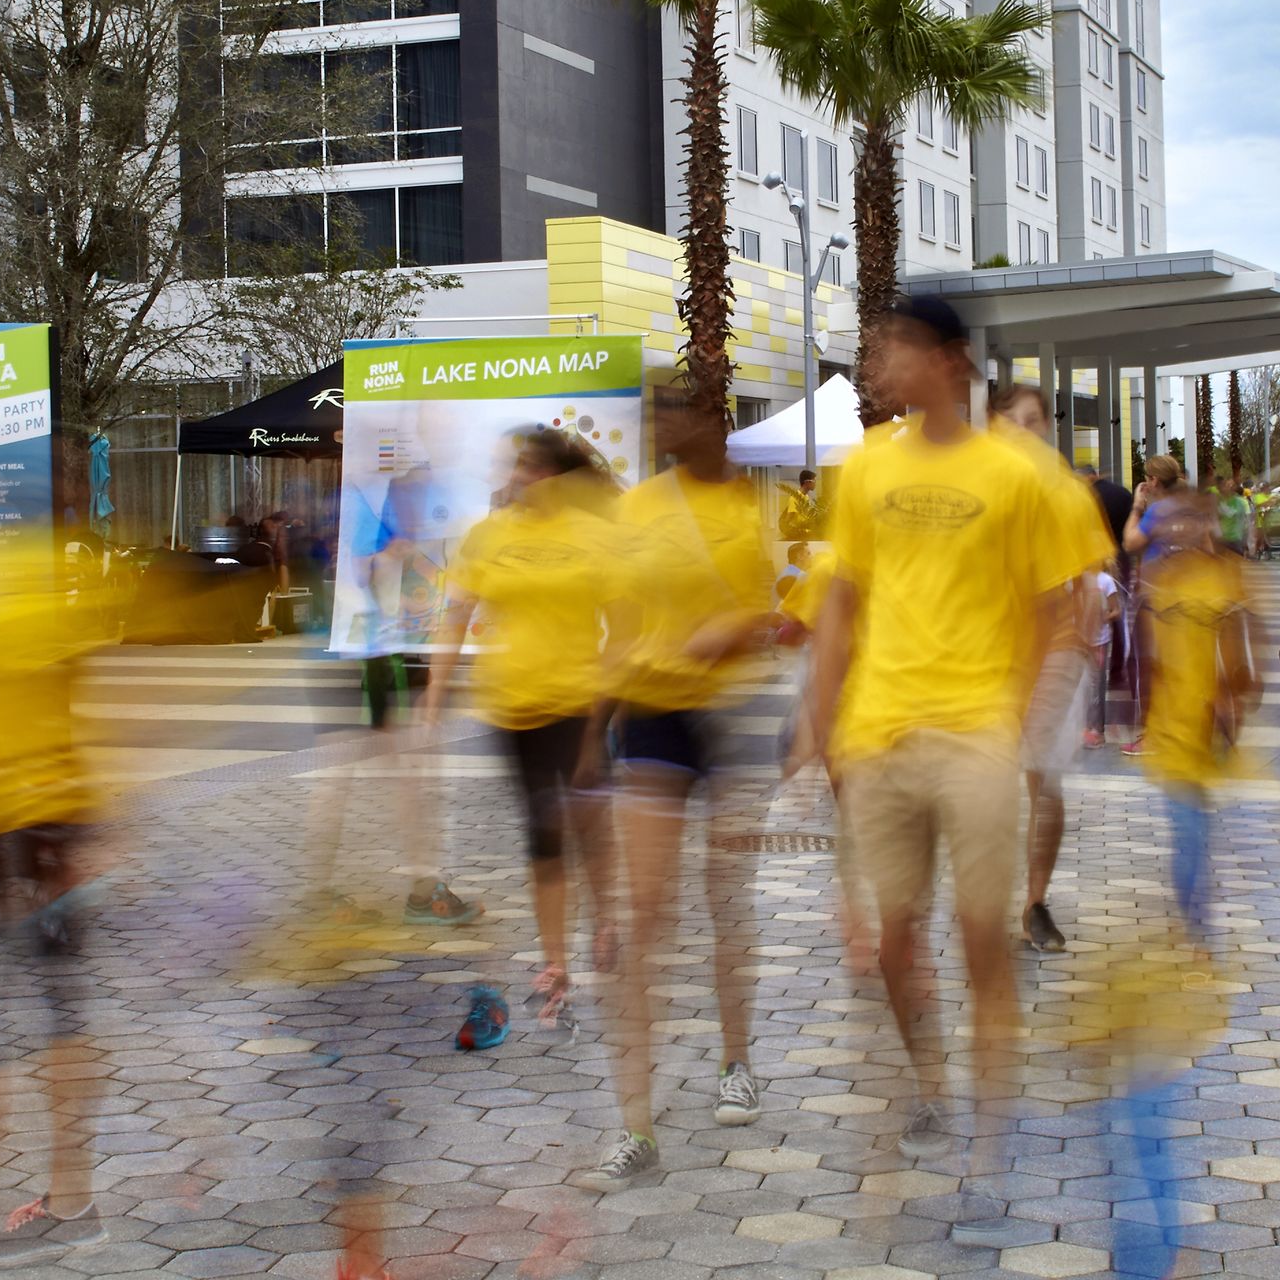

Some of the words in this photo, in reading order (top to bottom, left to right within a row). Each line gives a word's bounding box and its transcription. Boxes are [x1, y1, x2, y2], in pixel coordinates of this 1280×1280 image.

[369, 360, 398, 376] RUN
[422, 362, 476, 385] LAKE
[484, 356, 552, 380] NONA
[559, 351, 609, 373] MAP
[364, 372, 405, 389] NONA
[4, 399, 45, 417] PARTY
[25, 417, 45, 431] PM
[281, 433, 320, 443] Smokehouse
